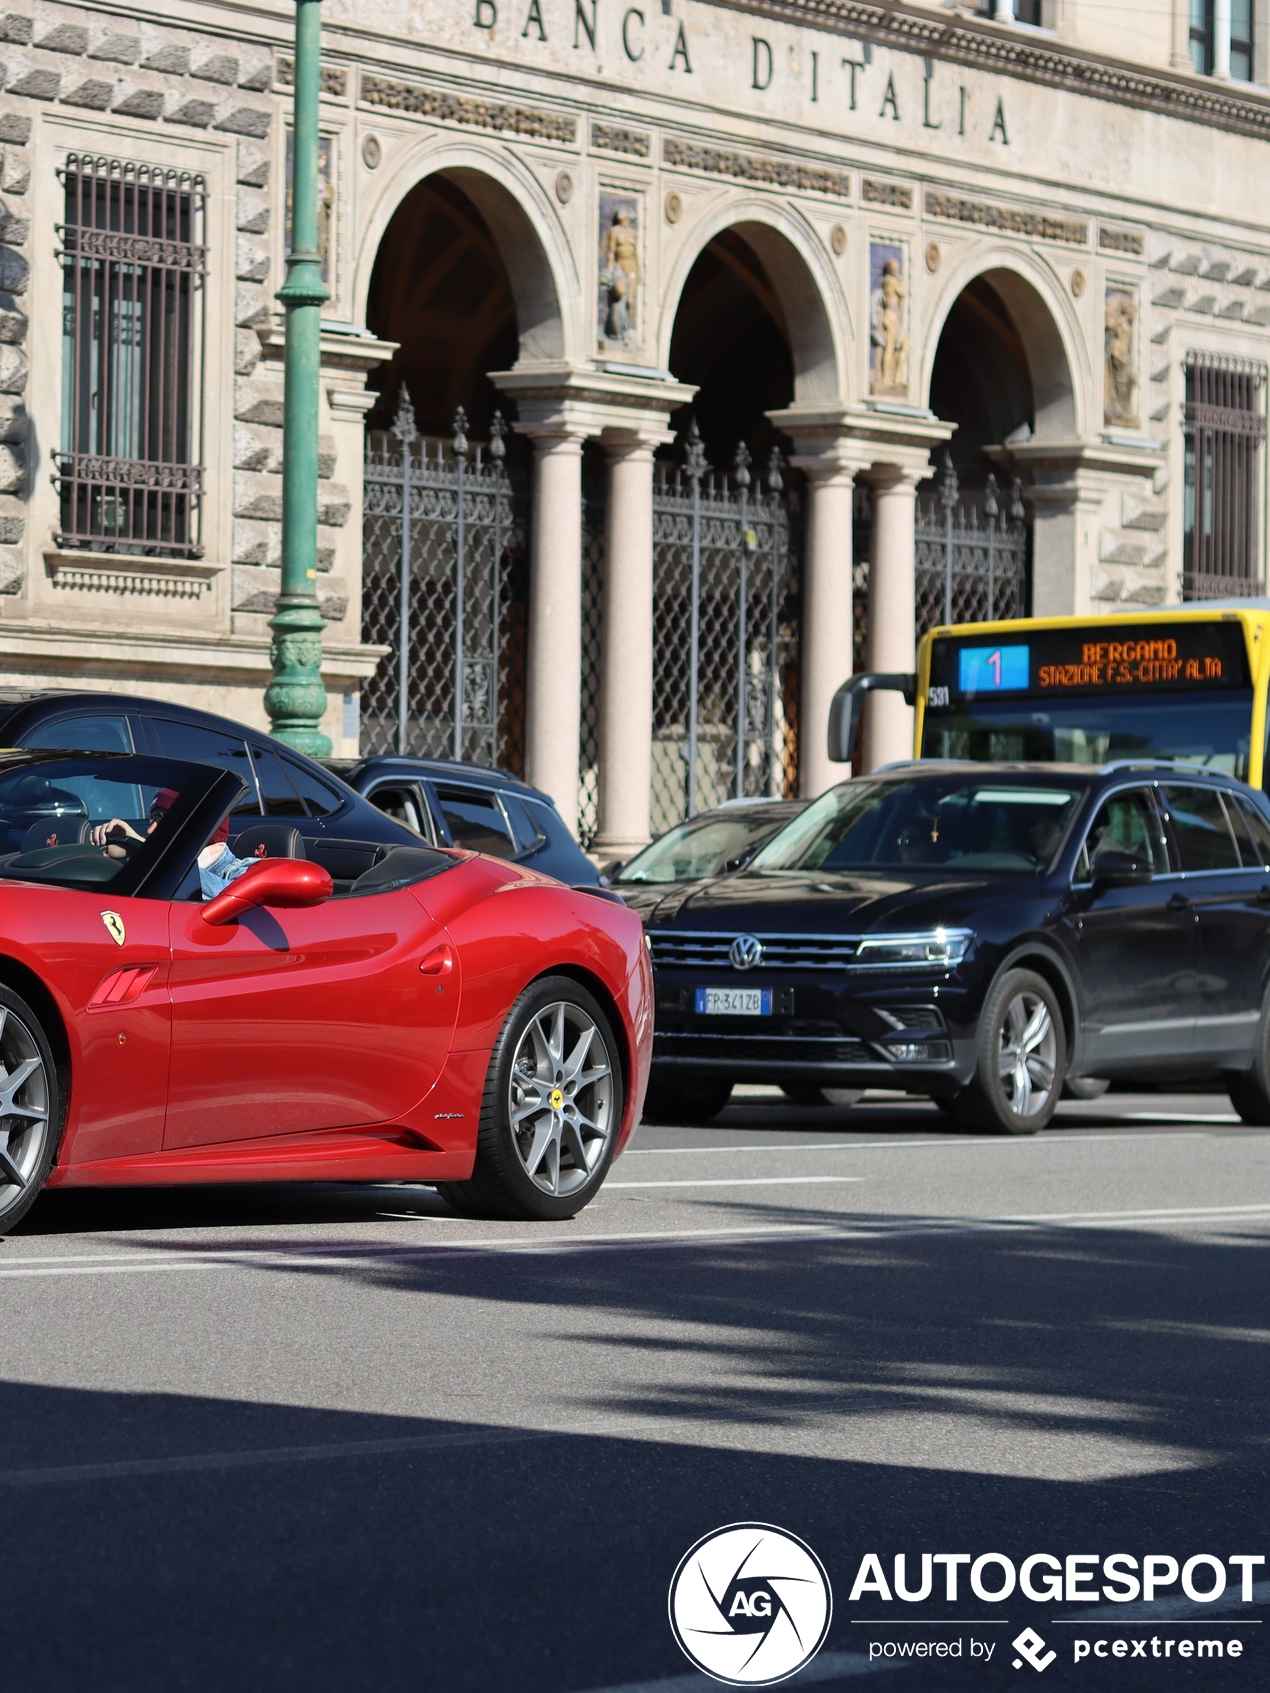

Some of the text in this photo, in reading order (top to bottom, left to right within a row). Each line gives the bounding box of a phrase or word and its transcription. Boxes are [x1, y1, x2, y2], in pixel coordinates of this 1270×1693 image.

[473, 0, 693, 73] BANCA
[1082, 638, 1177, 664] BERGAMO
[987, 650, 1001, 687] 1
[1038, 663, 1104, 688] STAZIONE
[1185, 656, 1222, 680] ALTA
